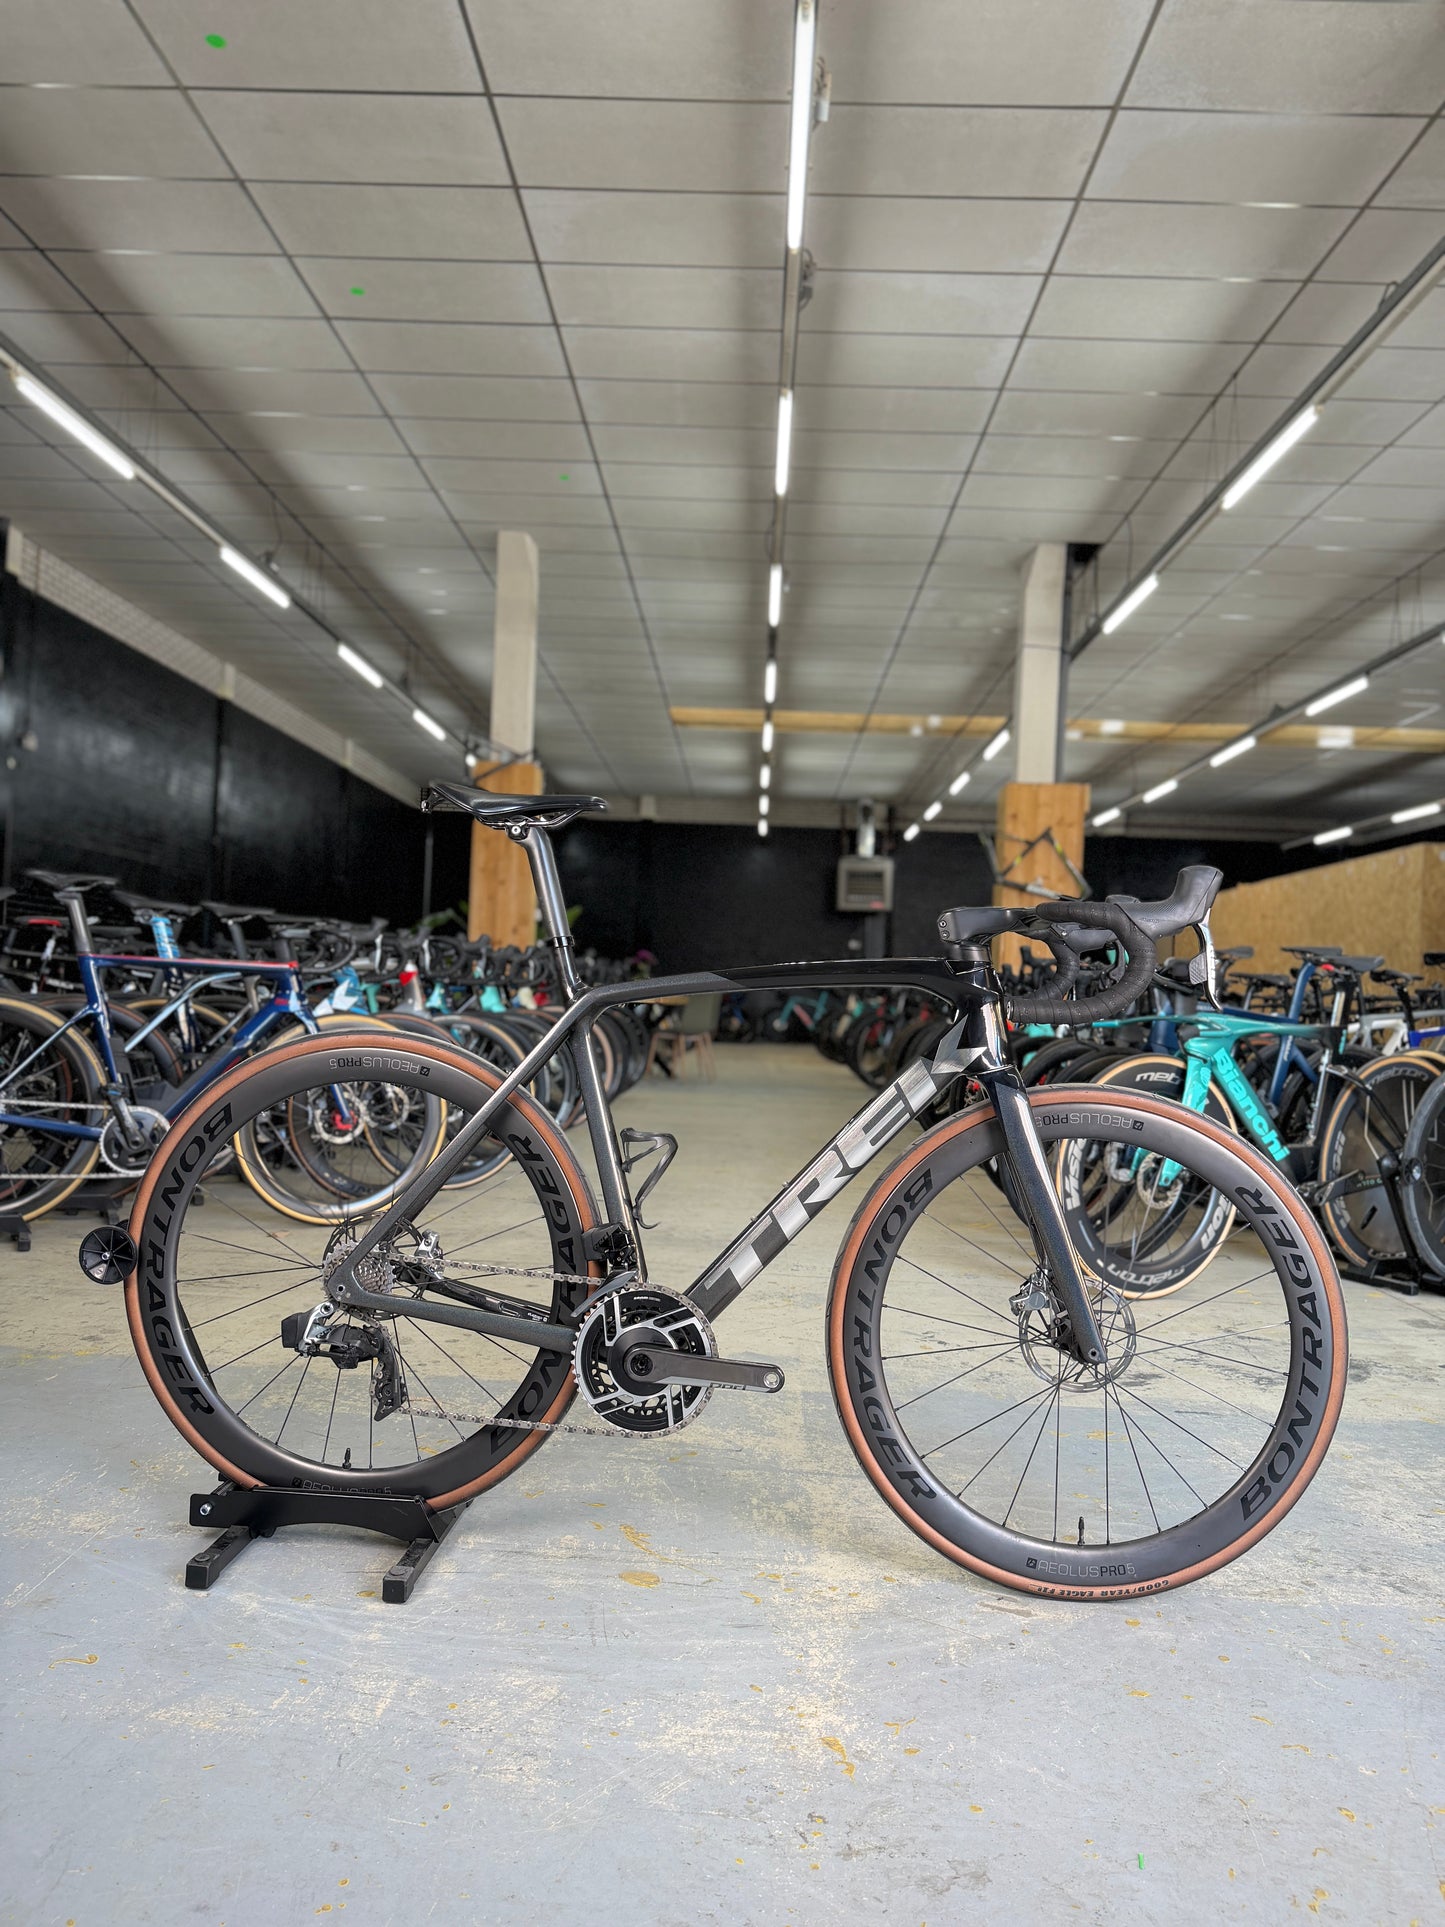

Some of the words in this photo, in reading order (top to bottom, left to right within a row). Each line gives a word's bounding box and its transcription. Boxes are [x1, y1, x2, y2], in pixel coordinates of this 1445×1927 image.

[704, 1014, 988, 1290] TREK
[1135, 1071, 1182, 1085] met
[1213, 1047, 1291, 1162] Bianchi
[147, 1102, 233, 1415] BONTRAGER
[490, 1133, 576, 1455] BONRAGER
[854, 1168, 937, 1499] BONTRAGER
[1106, 1262, 1187, 1287] metron
[1235, 1186, 1322, 1521] BONTRAGER
[1059, 1589, 1094, 1597] EAGLE
